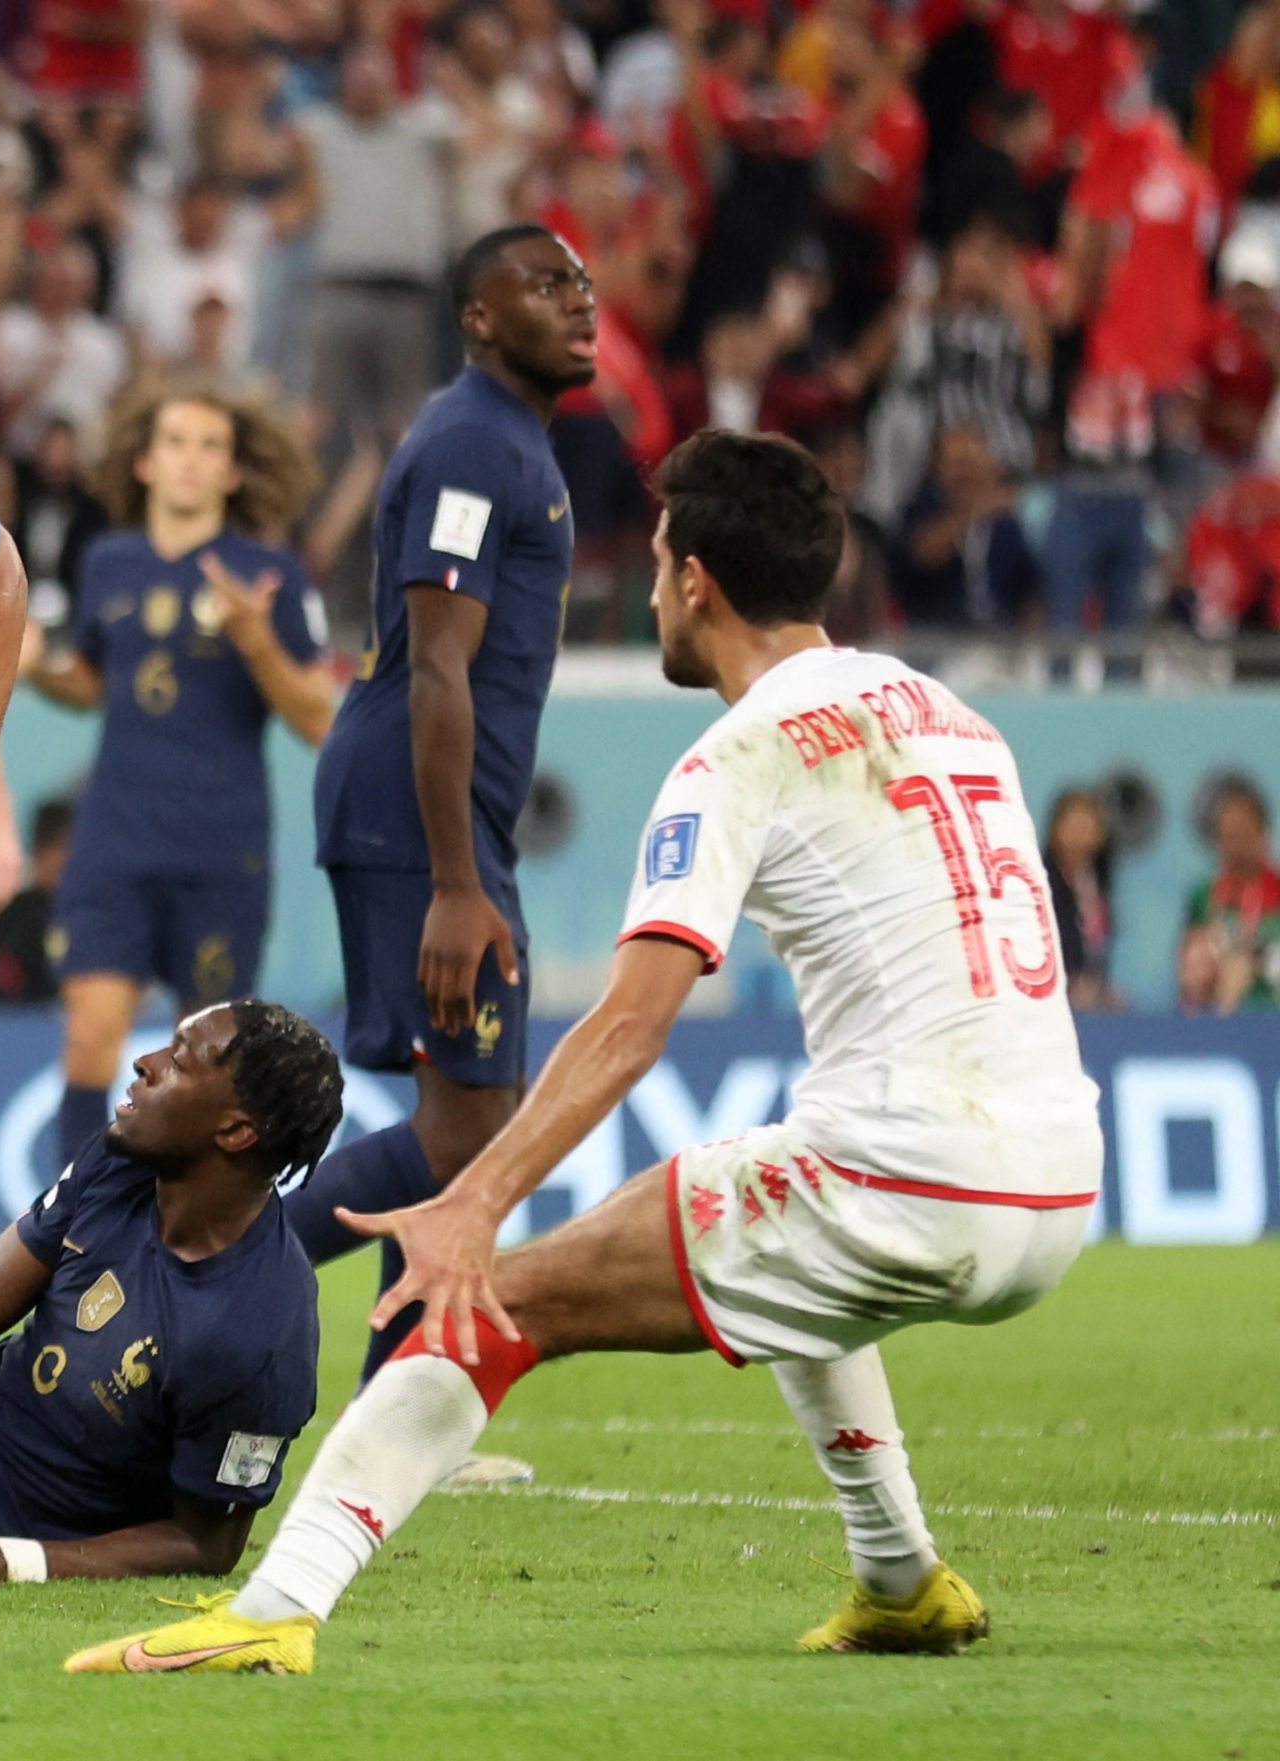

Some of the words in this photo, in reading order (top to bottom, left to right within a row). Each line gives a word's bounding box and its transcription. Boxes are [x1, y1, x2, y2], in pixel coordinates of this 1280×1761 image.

[133, 648, 179, 716] 6
[777, 703, 867, 770] BEN
[885, 774, 1059, 1000] 15
